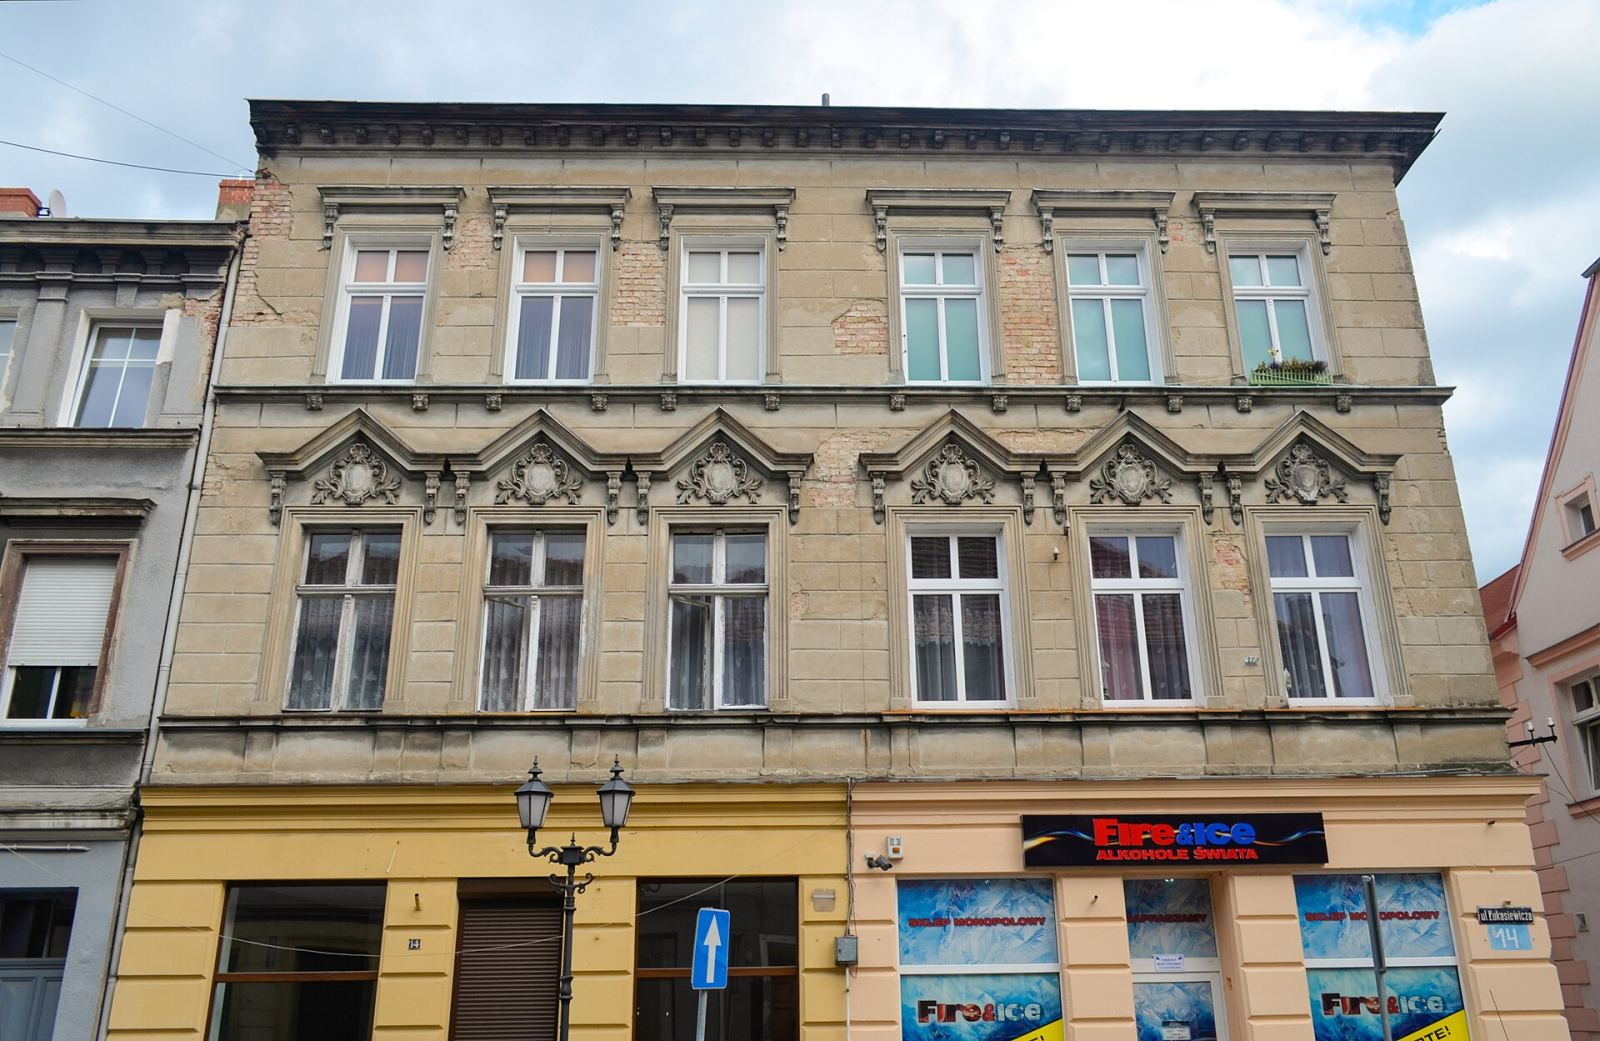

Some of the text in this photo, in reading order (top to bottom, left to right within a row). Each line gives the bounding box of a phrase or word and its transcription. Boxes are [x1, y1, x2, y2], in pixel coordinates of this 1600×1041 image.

[1095, 846, 1258, 861] ALKOHOLE ŚWIATA
[909, 916, 1046, 927] SKLEP MONOPOLOWY
[1305, 910, 1440, 922] SKLEP MOOPOLOWY
[1494, 928, 1519, 949] 14
